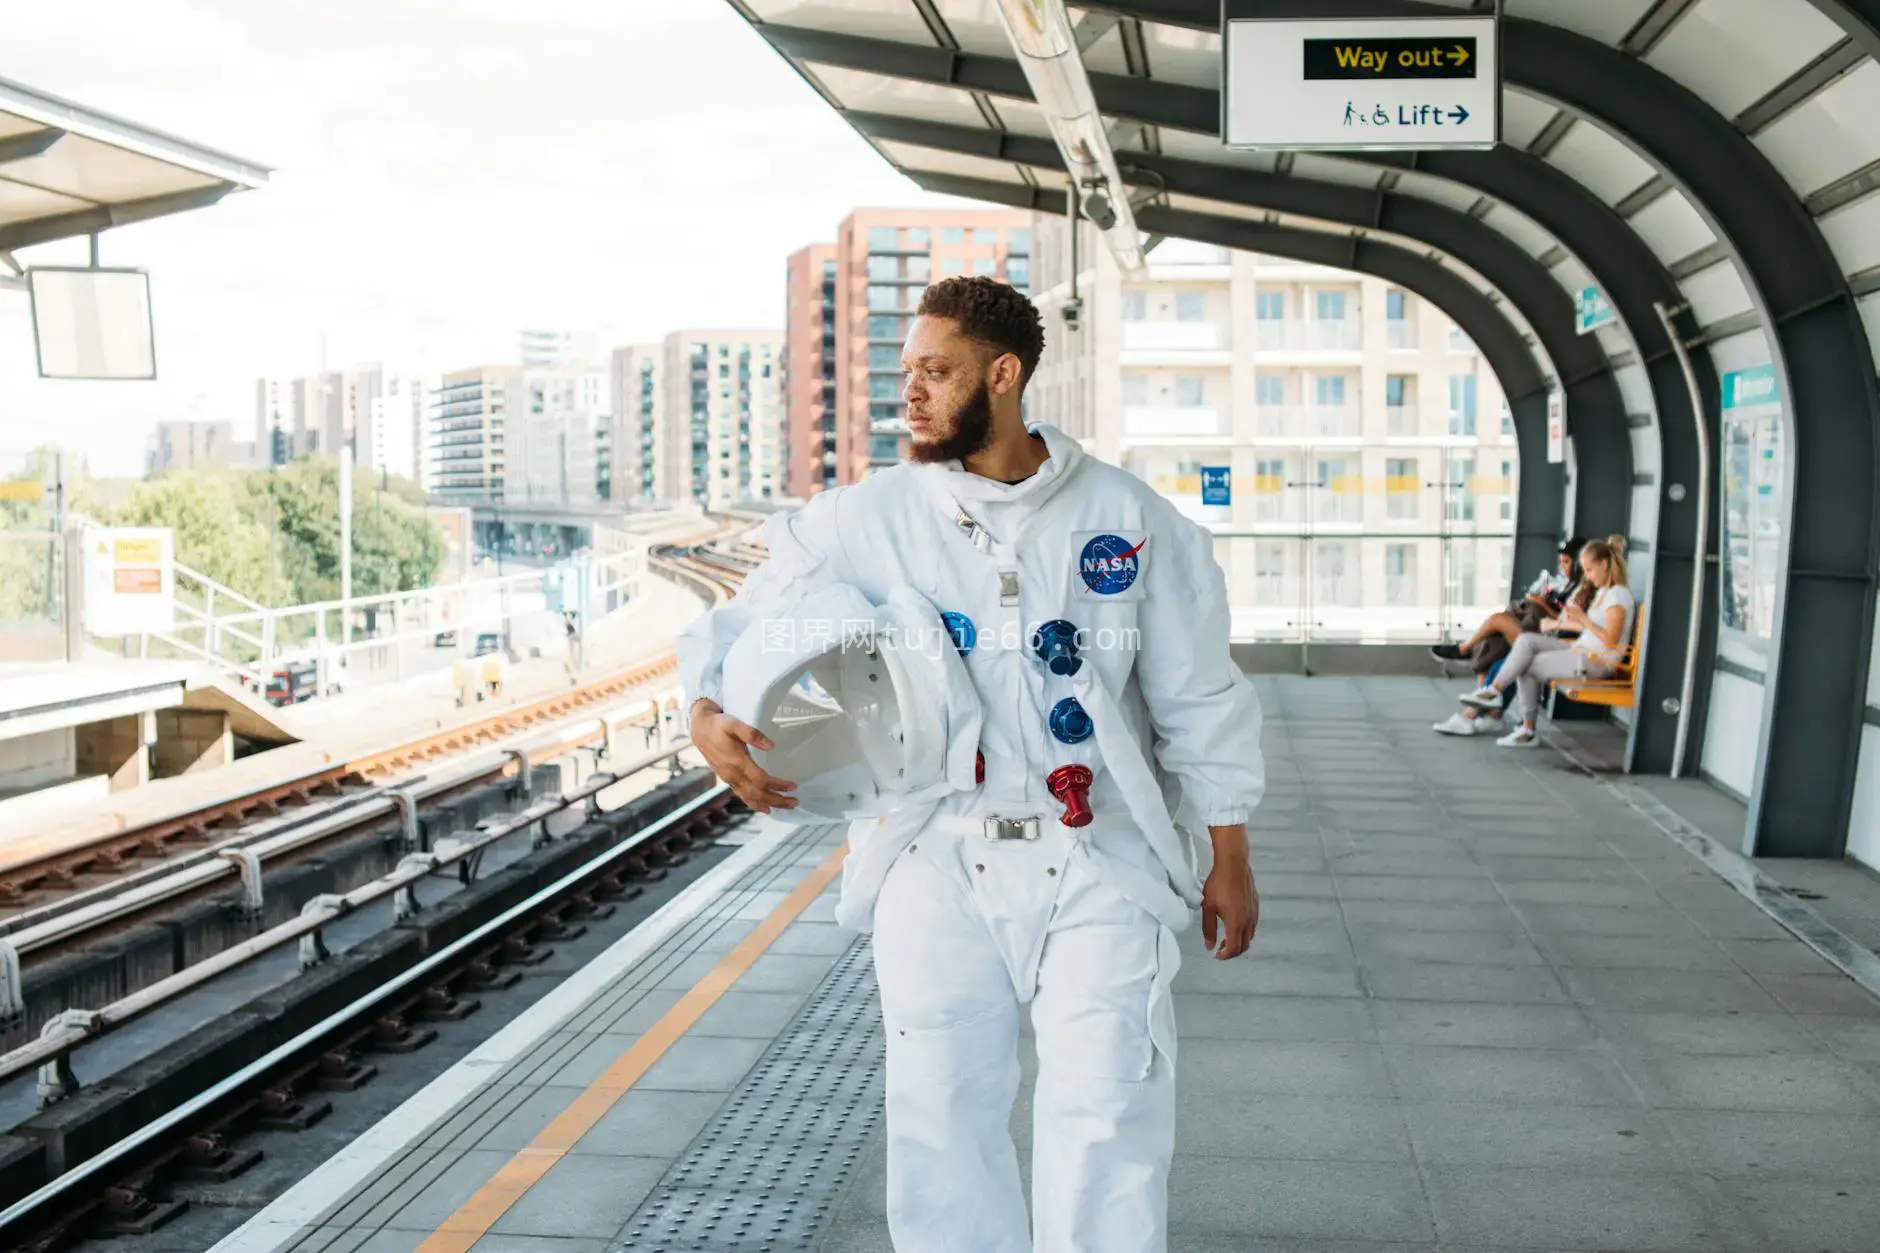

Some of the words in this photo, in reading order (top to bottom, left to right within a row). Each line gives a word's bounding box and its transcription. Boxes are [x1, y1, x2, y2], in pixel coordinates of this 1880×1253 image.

[1335, 45, 1388, 72] Way
[1398, 46, 1443, 67] out
[1398, 104, 1443, 125] Lift
[1083, 557, 1136, 572] NASA
